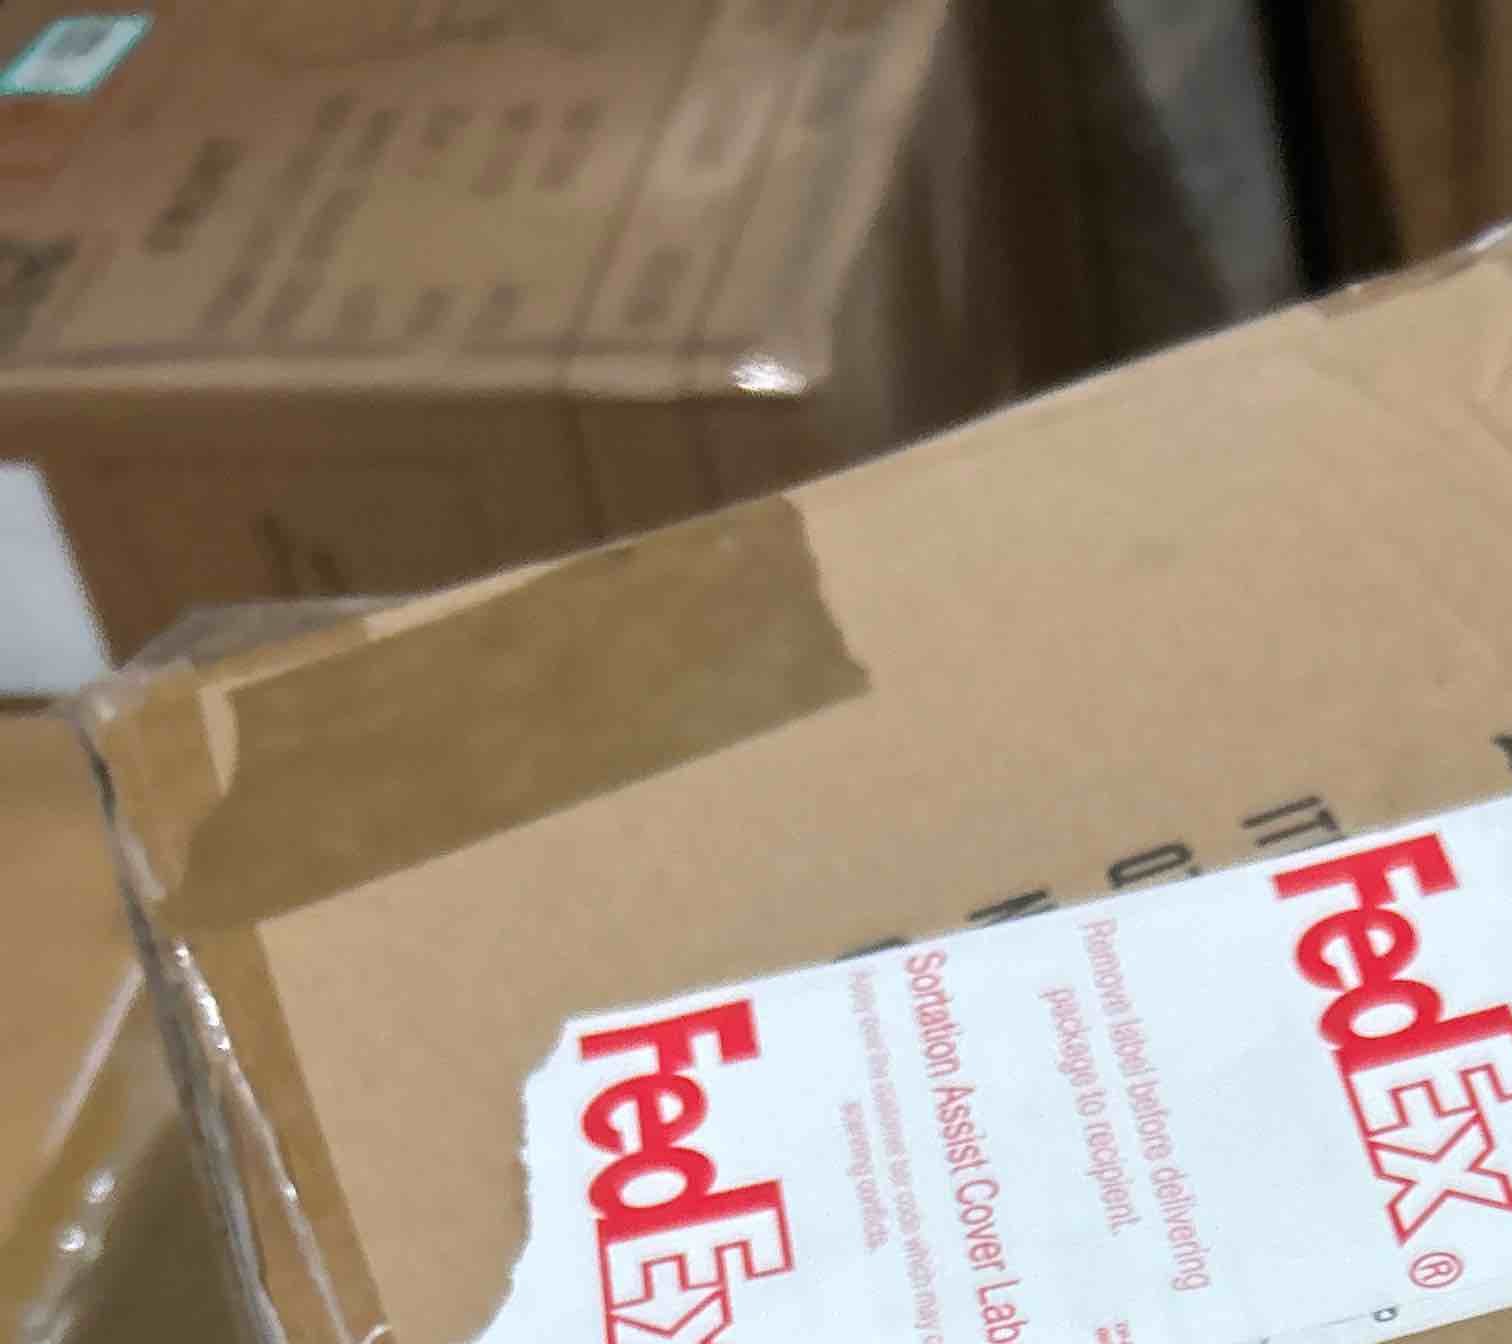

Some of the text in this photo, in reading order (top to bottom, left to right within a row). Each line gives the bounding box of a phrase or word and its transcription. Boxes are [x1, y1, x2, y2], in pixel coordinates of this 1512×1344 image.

[904, 948, 960, 1076] Sortation
[934, 1082, 986, 1174] Assist
[955, 1178, 1008, 1272] Cover
[1127, 1079, 1174, 1163] before
[1152, 1165, 1210, 1292] delivering
